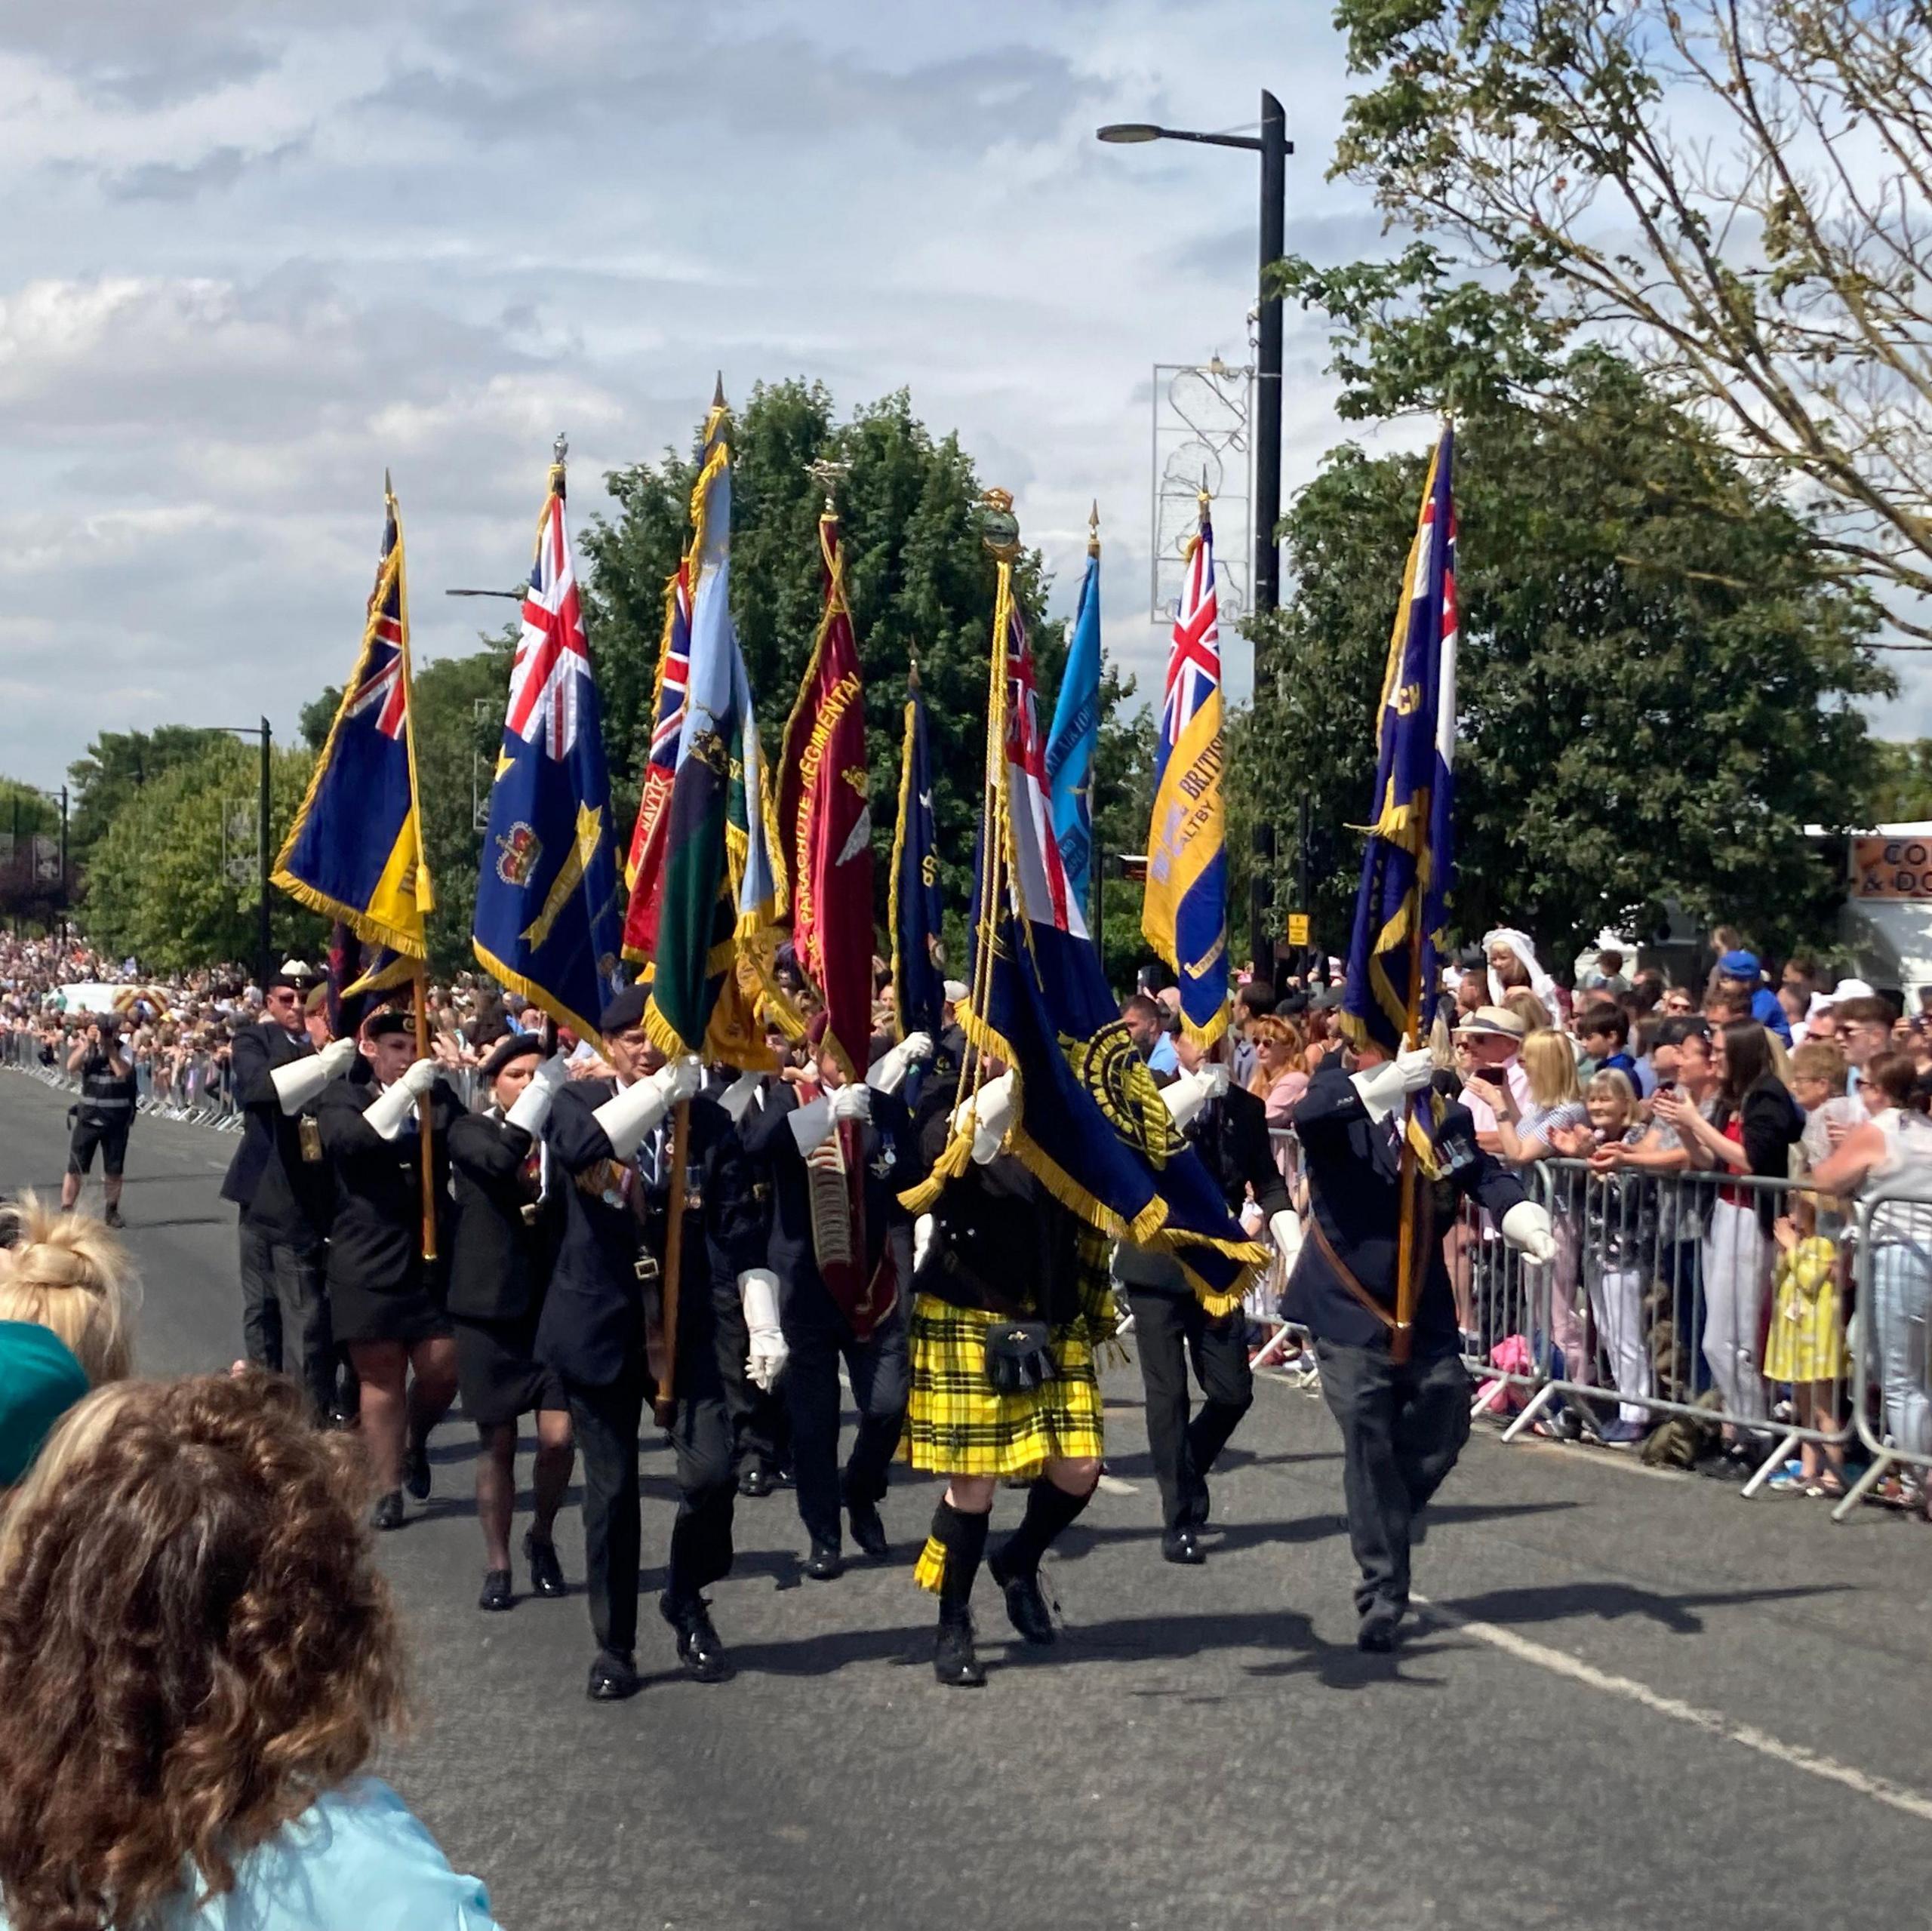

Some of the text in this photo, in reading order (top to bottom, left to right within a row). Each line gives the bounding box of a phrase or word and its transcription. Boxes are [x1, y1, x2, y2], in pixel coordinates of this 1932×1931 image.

[1178, 727, 1226, 801] BRITIS
[640, 786, 663, 832] NAVY
[795, 795, 814, 924] PARACHUTE
